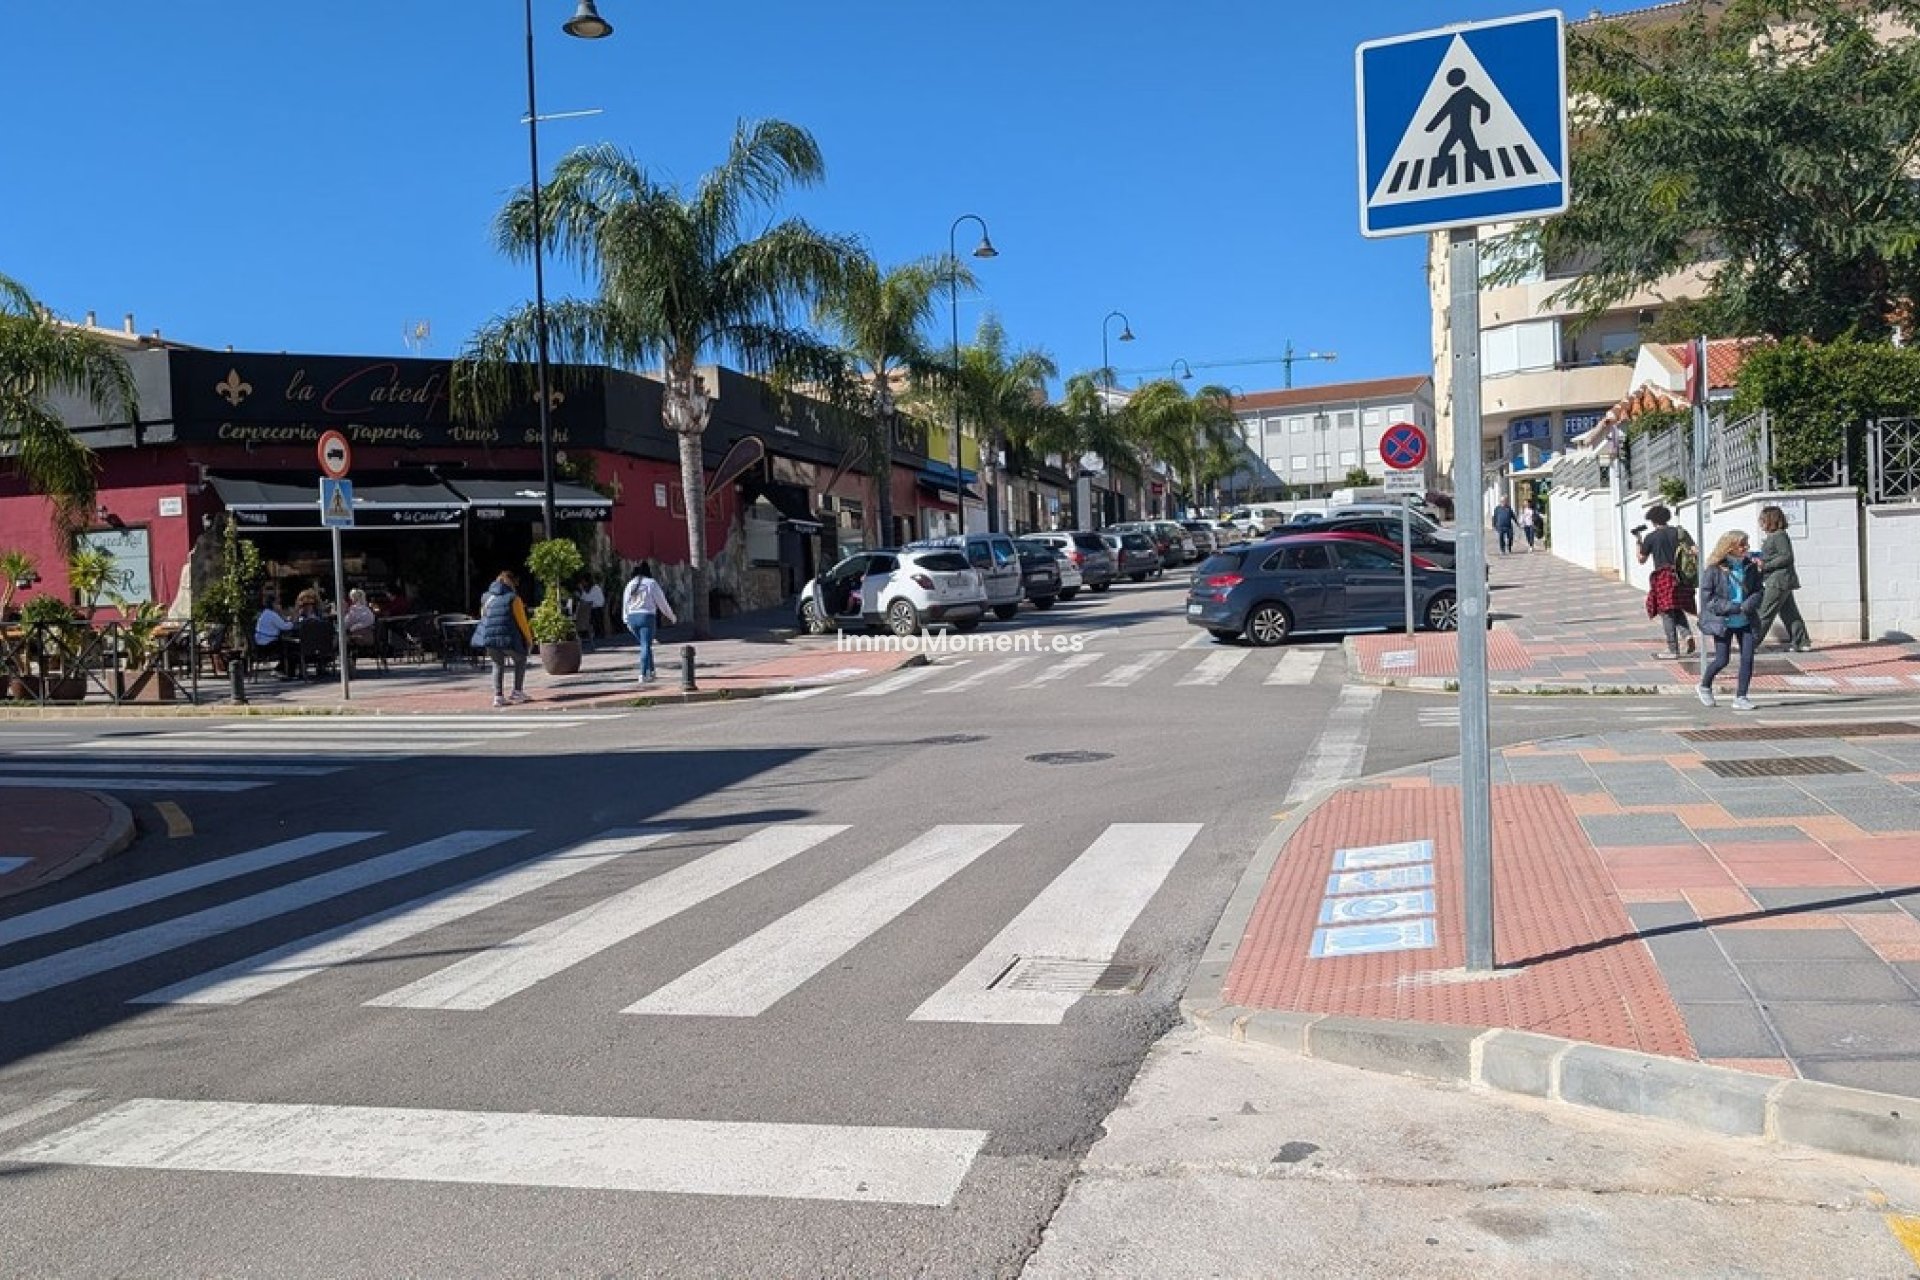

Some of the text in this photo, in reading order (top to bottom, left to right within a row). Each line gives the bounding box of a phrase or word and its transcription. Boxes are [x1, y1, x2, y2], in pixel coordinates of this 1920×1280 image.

[285, 369, 316, 401] la
[448, 427, 500, 441] Vinos
[525, 428, 569, 442] Suhi
